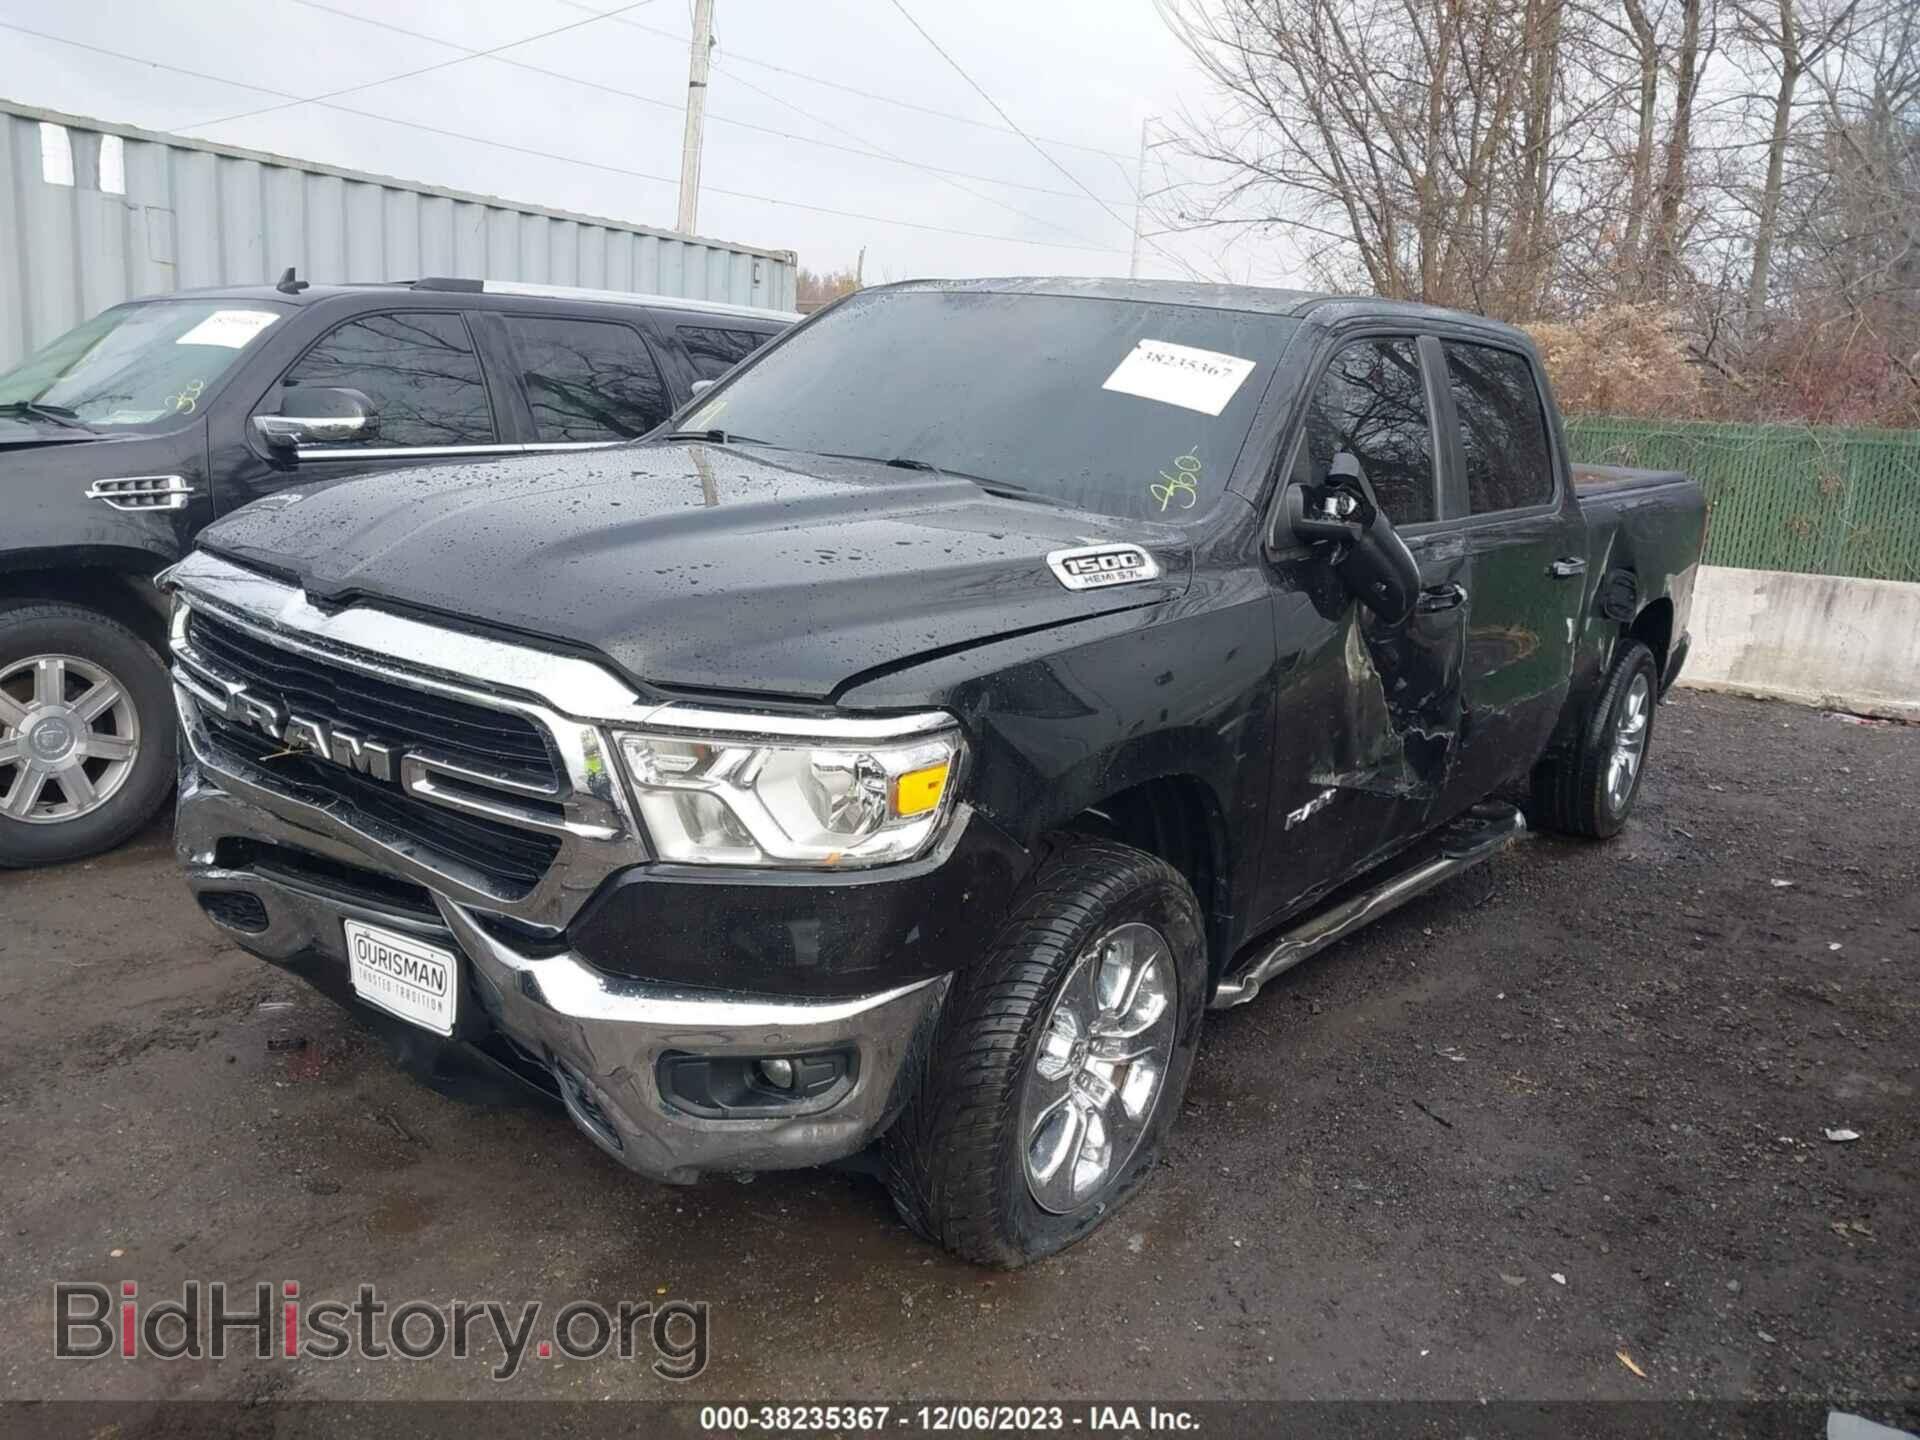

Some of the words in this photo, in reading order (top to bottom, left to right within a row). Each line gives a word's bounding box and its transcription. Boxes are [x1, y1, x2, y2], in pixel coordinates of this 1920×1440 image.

[1063, 553, 1140, 575] 1500
[1082, 572, 1117, 584] HEMI
[233, 691, 392, 782] RAM
[357, 938, 444, 992] OURISMAN
